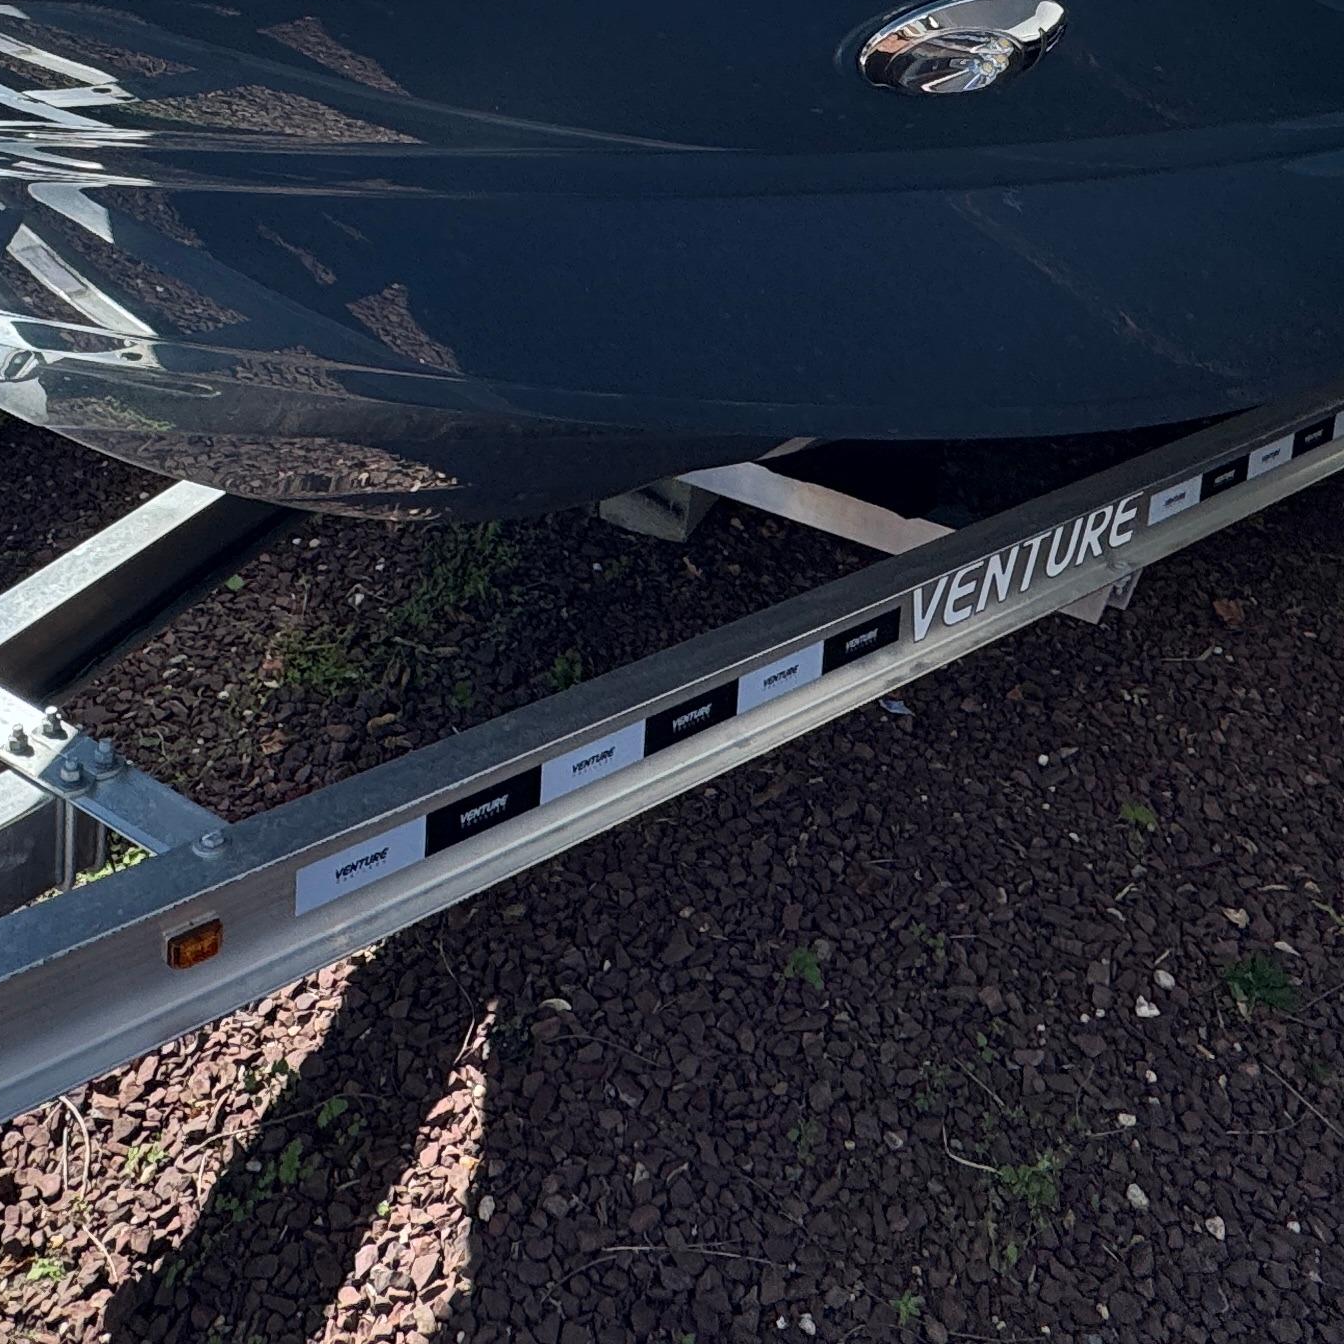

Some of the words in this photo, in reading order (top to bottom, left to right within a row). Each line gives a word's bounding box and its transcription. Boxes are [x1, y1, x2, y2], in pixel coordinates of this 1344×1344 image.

[912, 491, 1144, 643] VENTURE
[572, 746, 615, 773] VENTURE
[460, 794, 508, 824] VENTURE
[335, 847, 389, 880] VENTURE
